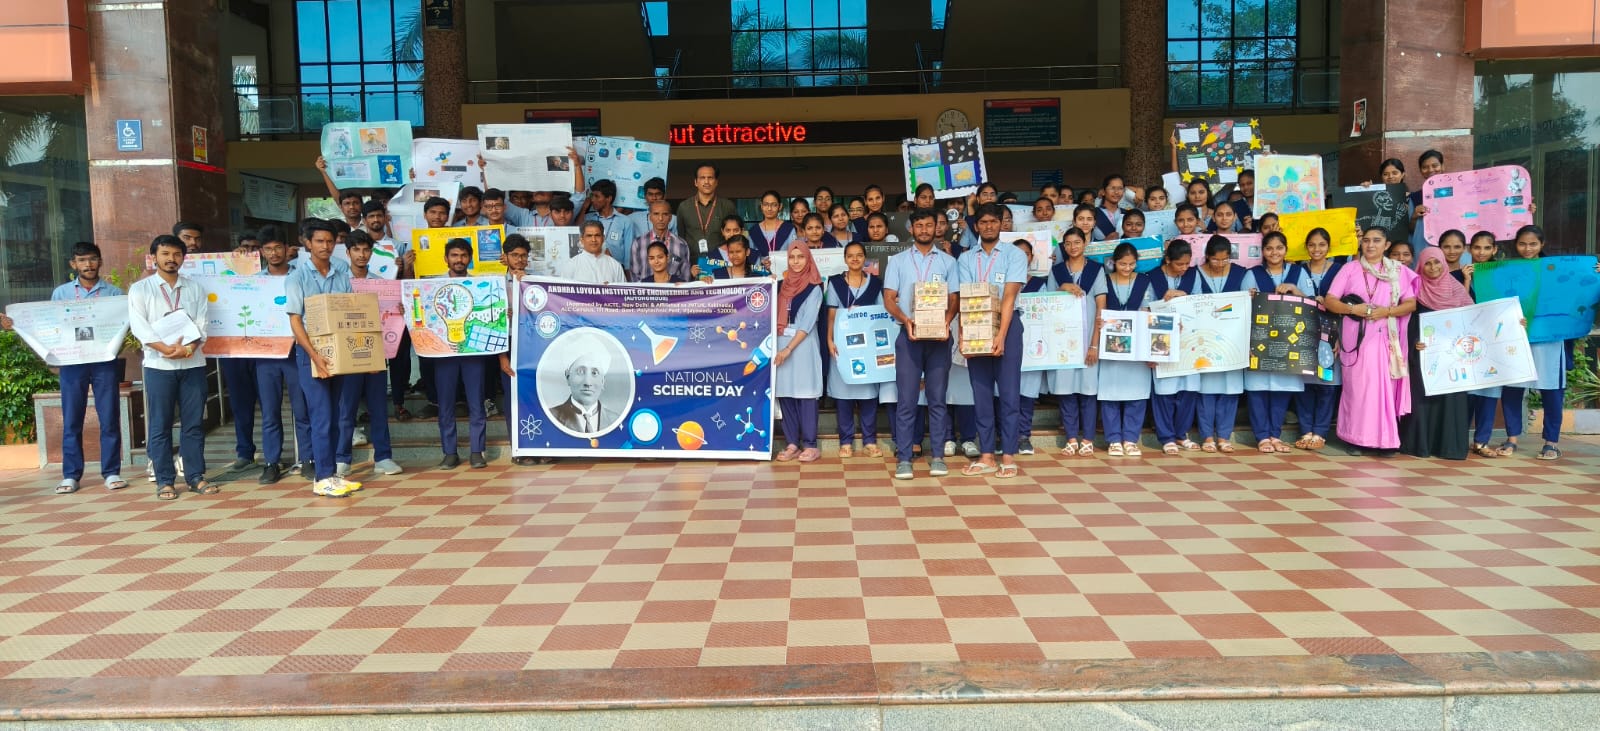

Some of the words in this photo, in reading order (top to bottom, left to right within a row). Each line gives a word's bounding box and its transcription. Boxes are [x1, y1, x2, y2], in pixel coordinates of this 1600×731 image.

[702, 122, 806, 143] attractive
[548, 286, 576, 294] ANDHRA
[602, 287, 636, 295] INSTITUTE
[705, 287, 746, 295] TECHNOLOGY
[665, 371, 733, 383] NATIONAL
[653, 385, 712, 396] SCIENCE
[715, 385, 744, 397] DAY
